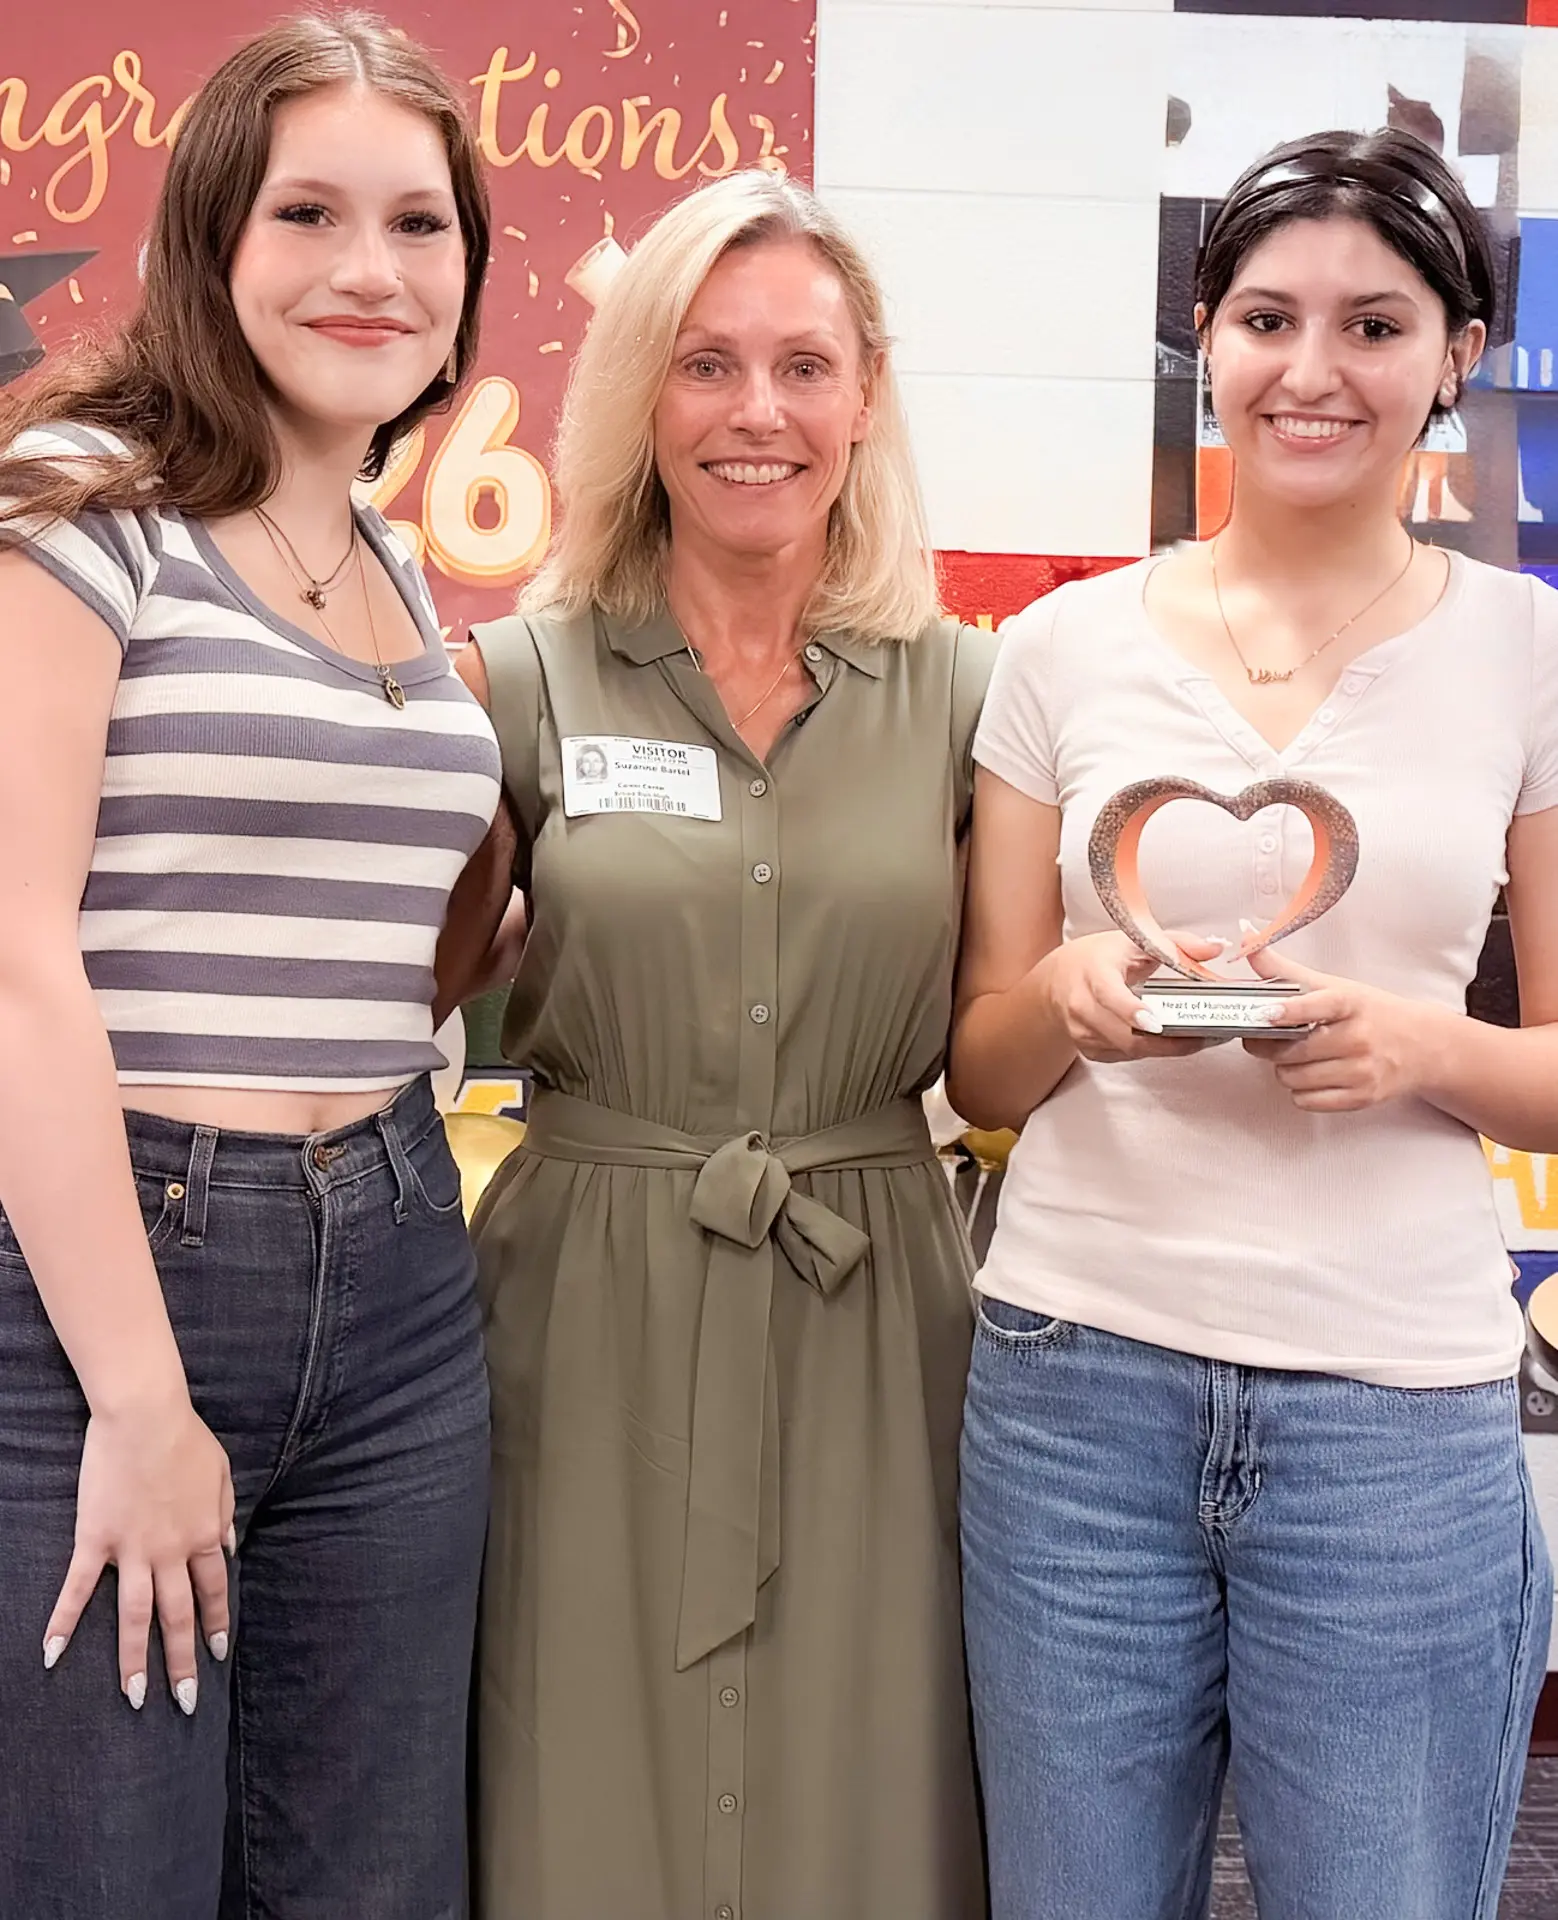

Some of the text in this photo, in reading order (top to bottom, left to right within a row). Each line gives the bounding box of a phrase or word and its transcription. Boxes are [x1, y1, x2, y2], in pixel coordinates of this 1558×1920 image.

[632, 744, 688, 760] VISITOR
[614, 761, 657, 773] Suzanne
[1162, 1001, 1188, 1010] Heart
[1191, 1001, 1200, 1011] of
[1203, 1001, 1246, 1012] Humanity
